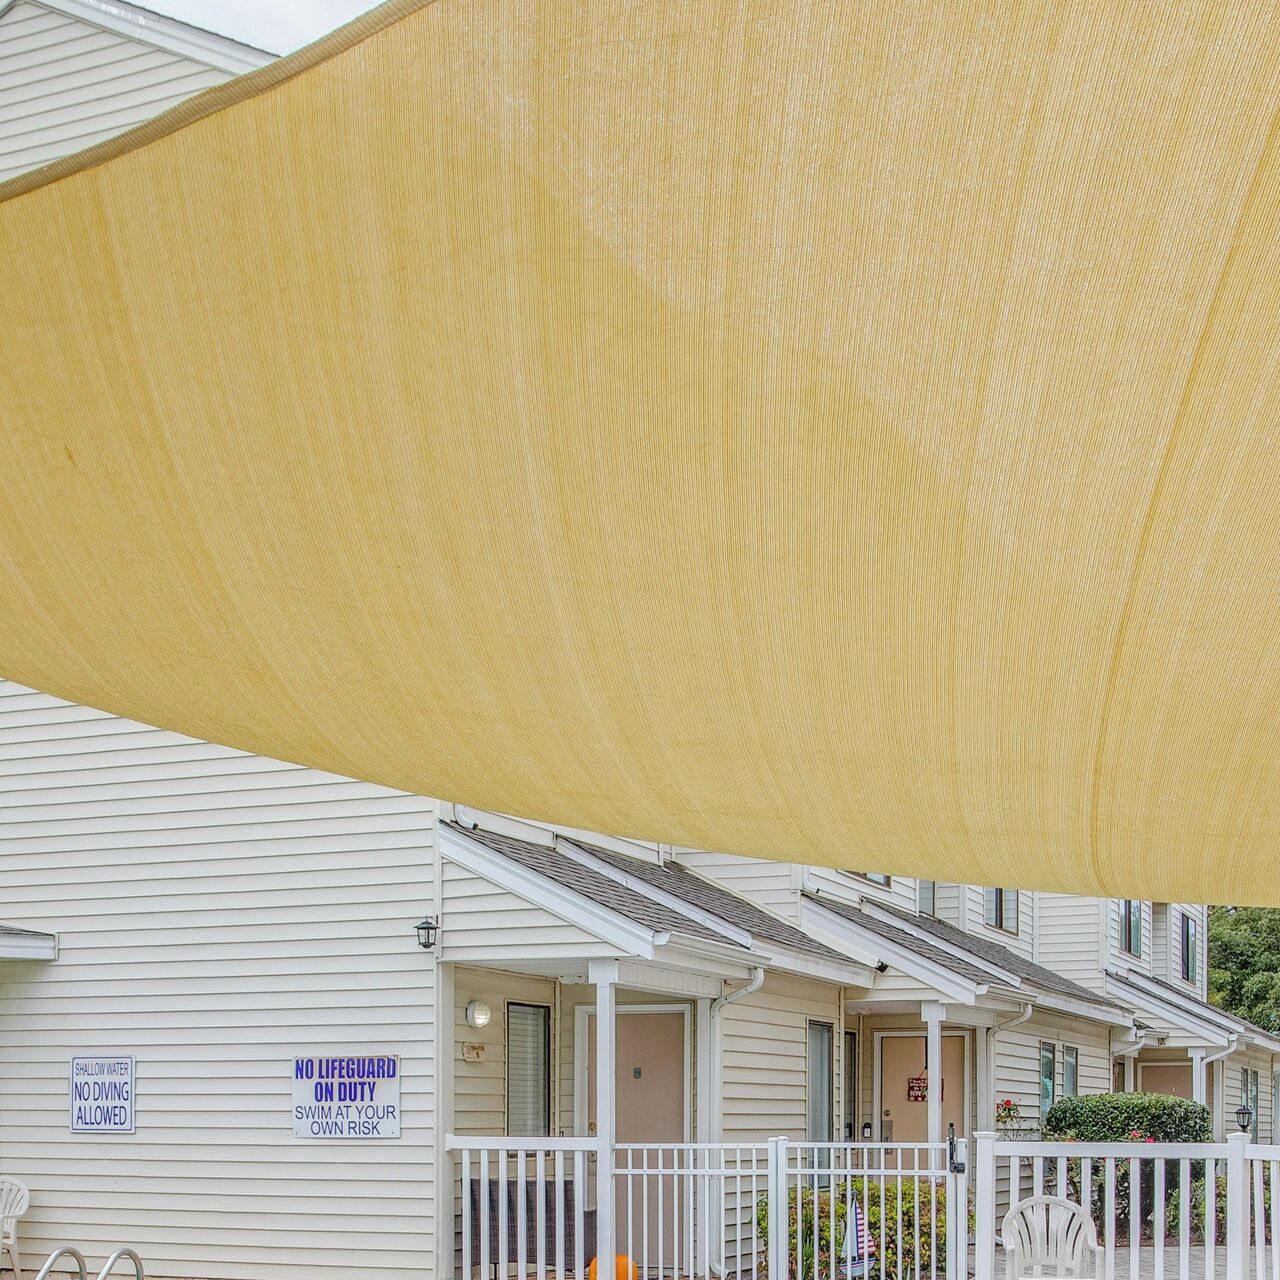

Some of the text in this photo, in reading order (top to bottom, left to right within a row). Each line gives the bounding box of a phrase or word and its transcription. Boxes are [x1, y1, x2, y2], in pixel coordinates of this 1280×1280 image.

[75, 1062, 129, 1076] SHALLOW WATER
[295, 1058, 397, 1079] NO LIFEGUARD
[74, 1081, 129, 1101] NO DIVING
[314, 1082, 377, 1103] ON DUTY
[76, 1106, 127, 1126] ALLOWED
[295, 1105, 396, 1120] SWIM AT YOUR
[310, 1121, 380, 1135] OWN RISK
